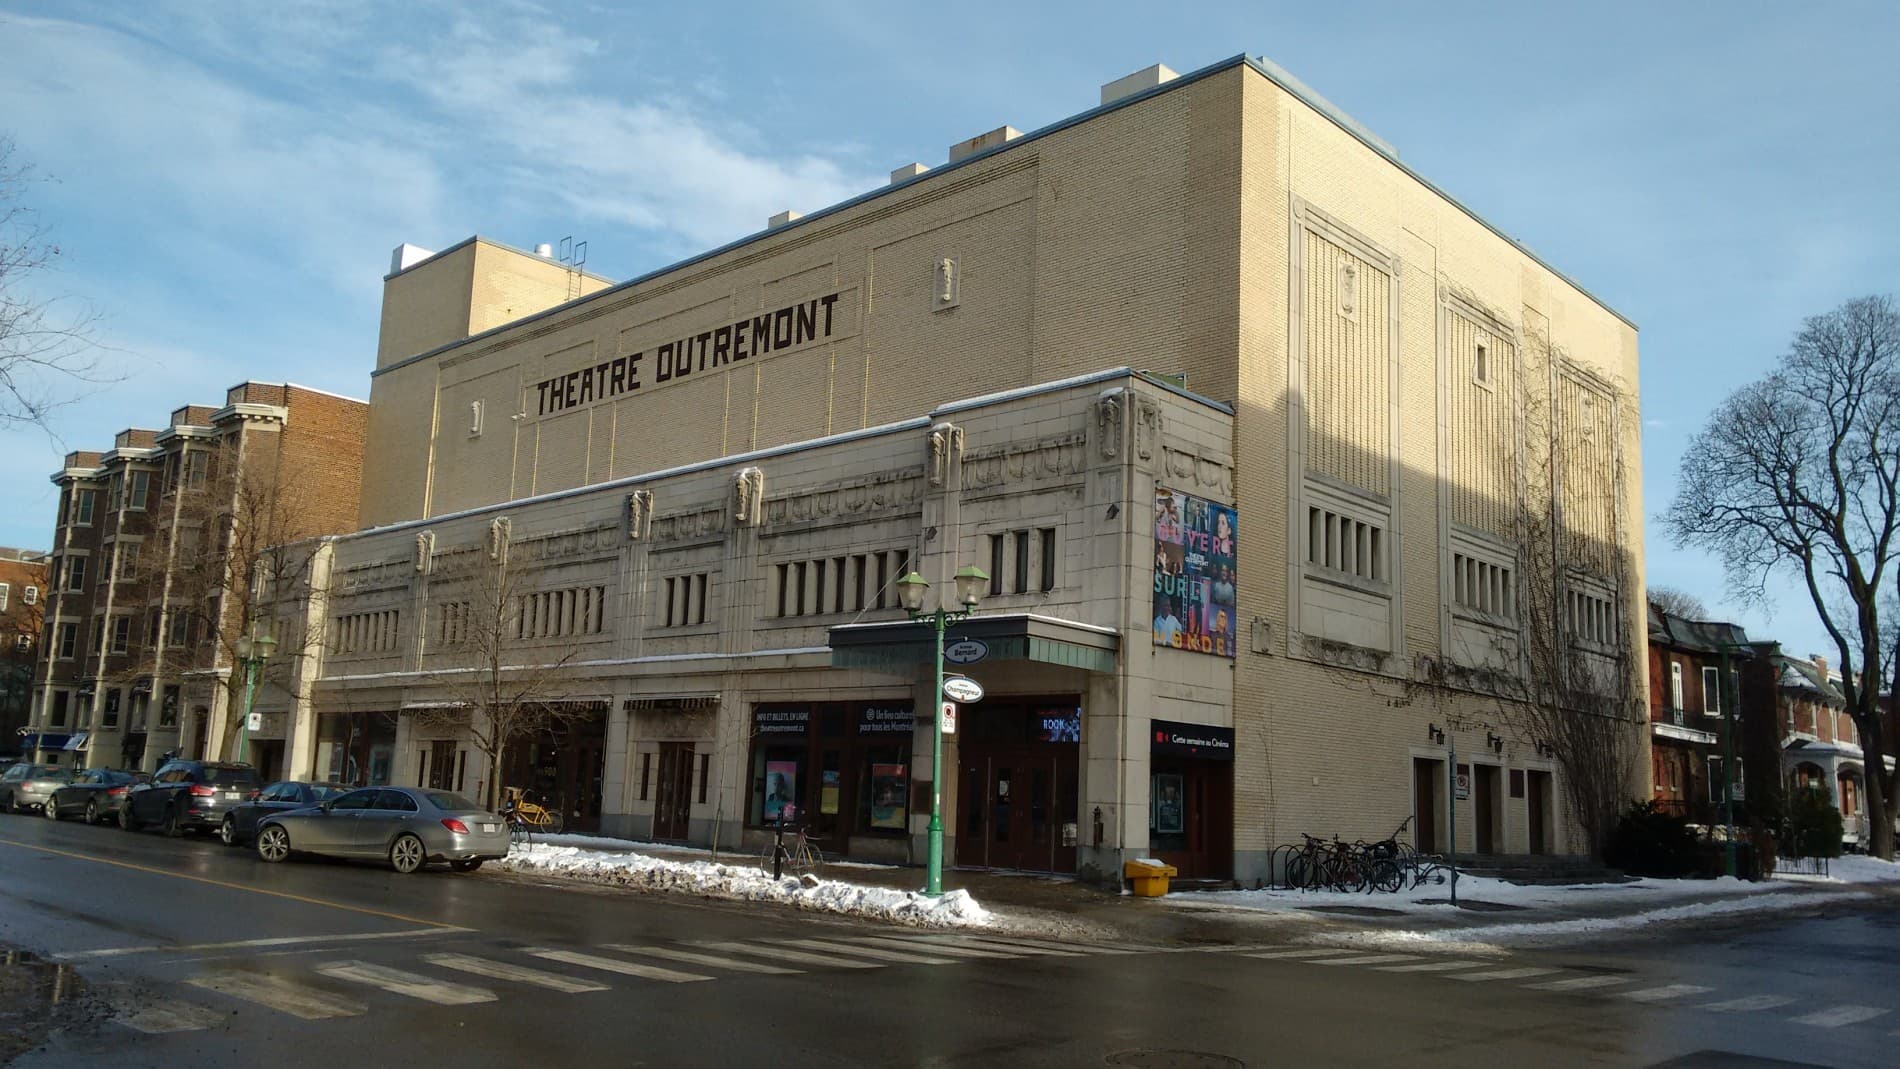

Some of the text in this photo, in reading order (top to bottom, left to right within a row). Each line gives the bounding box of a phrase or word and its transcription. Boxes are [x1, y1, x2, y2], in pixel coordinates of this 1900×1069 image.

[537, 294, 838, 415] THEATRE OUTREMONT
[1158, 523, 1234, 558] OUVERT
[1154, 573, 1187, 598] SUR
[954, 648, 977, 656] Bernard
[1154, 630, 1226, 656] MONDE
[946, 685, 979, 696] Champagneur
